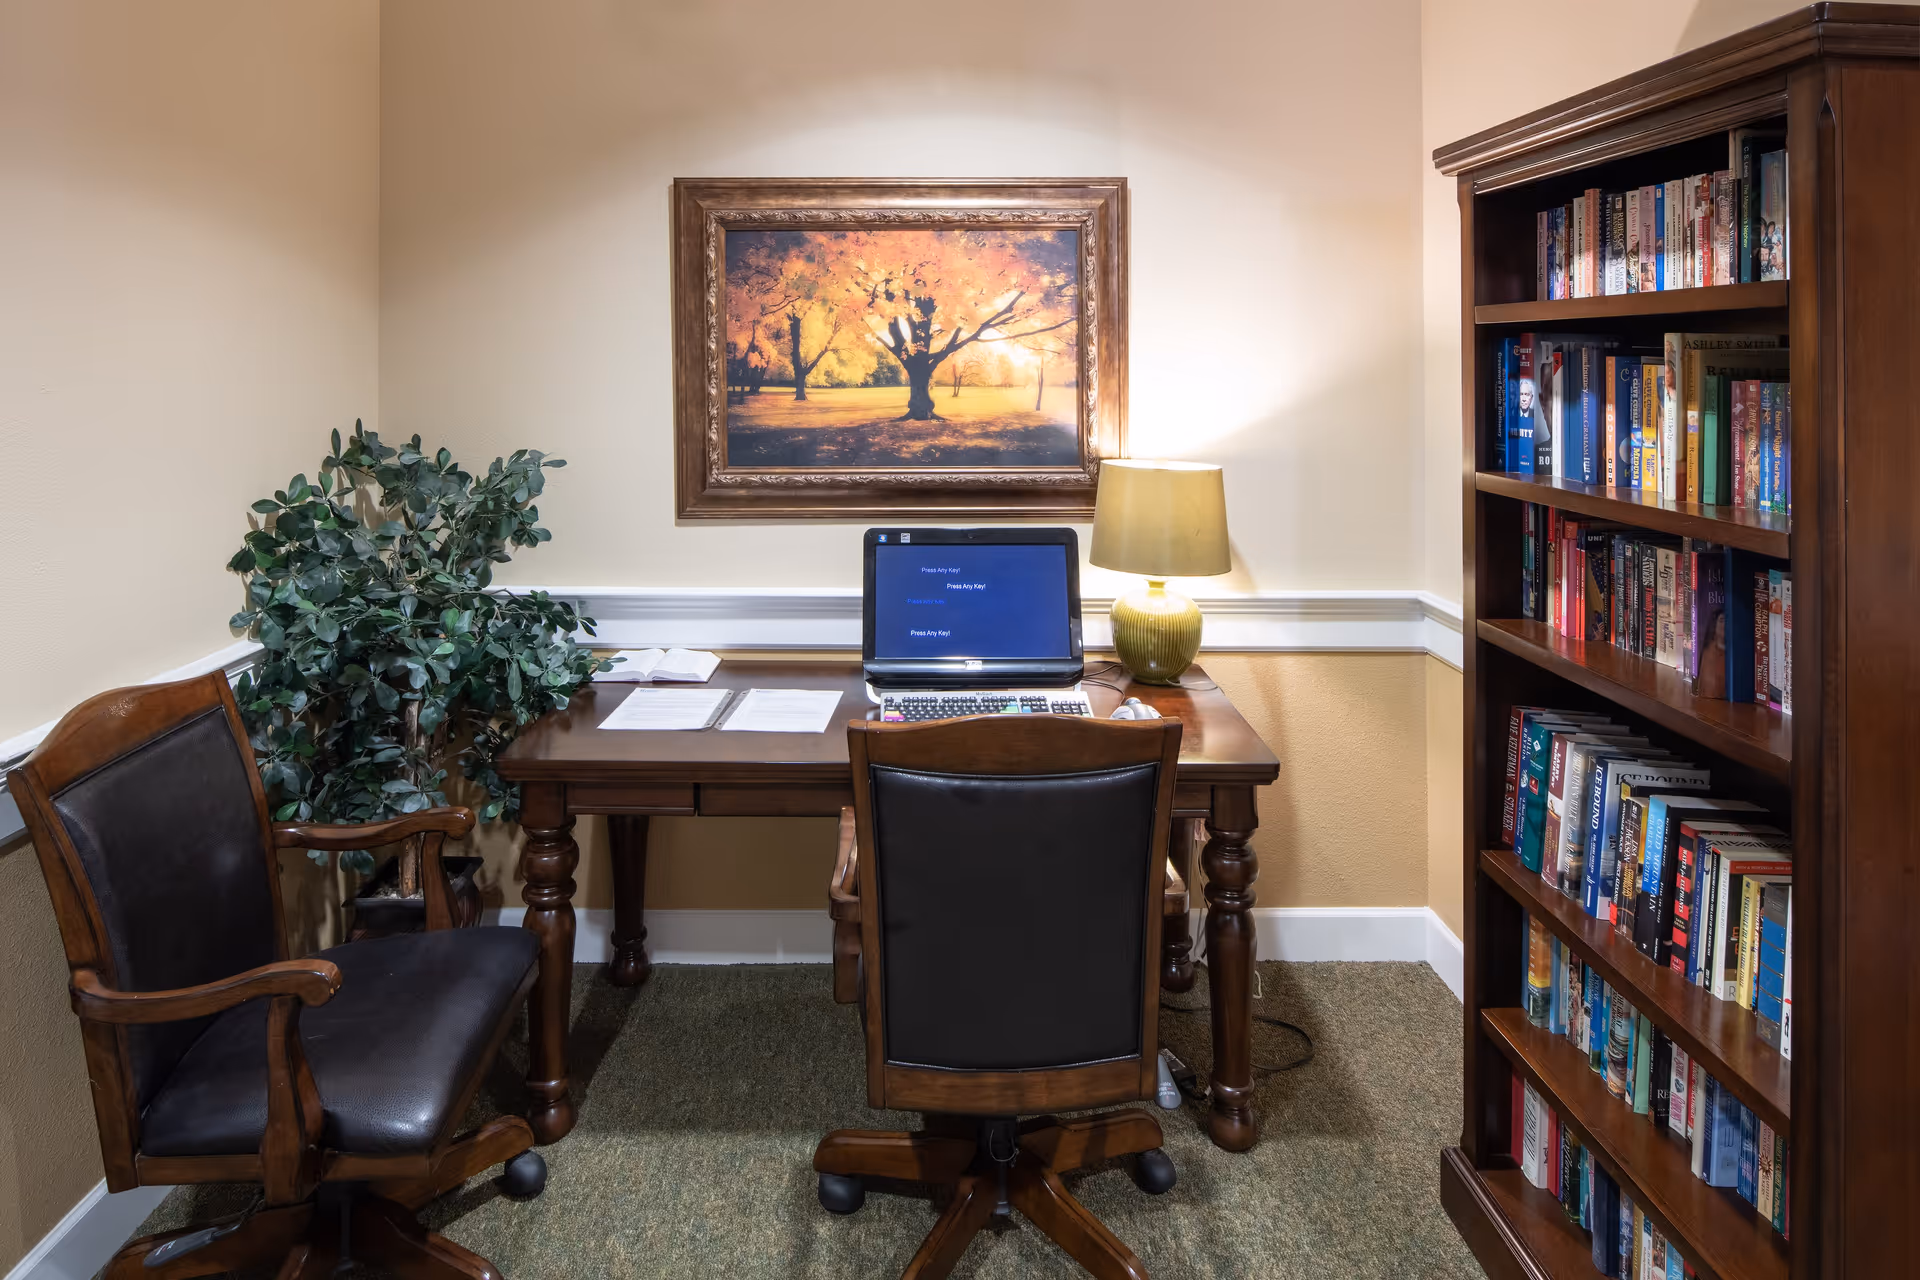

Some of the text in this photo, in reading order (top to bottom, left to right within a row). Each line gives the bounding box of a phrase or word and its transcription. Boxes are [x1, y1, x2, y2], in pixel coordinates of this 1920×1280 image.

[1743, 146, 1750, 154] C.
[1742, 195, 1750, 224] Magician's
[1742, 224, 1750, 248] Nephew
[1684, 340, 1776, 349] ASHLEY SMITH
[1773, 410, 1782, 458] Silent Knight
[1708, 592, 1724, 604] Blu
[1644, 616, 1655, 647] GAME
[1506, 716, 1519, 780] FAYE KELLERMAN
[1502, 794, 1514, 831] STALKER
[1568, 799, 1579, 821] WALK
[1592, 764, 1603, 830] ICE BOUND
[1623, 827, 1634, 862] JACKSON
[1643, 850, 1651, 882] FRAZIER
[1648, 852, 1660, 912] MOUNTAIN
[1678, 879, 1686, 914] ELEPHANTS
